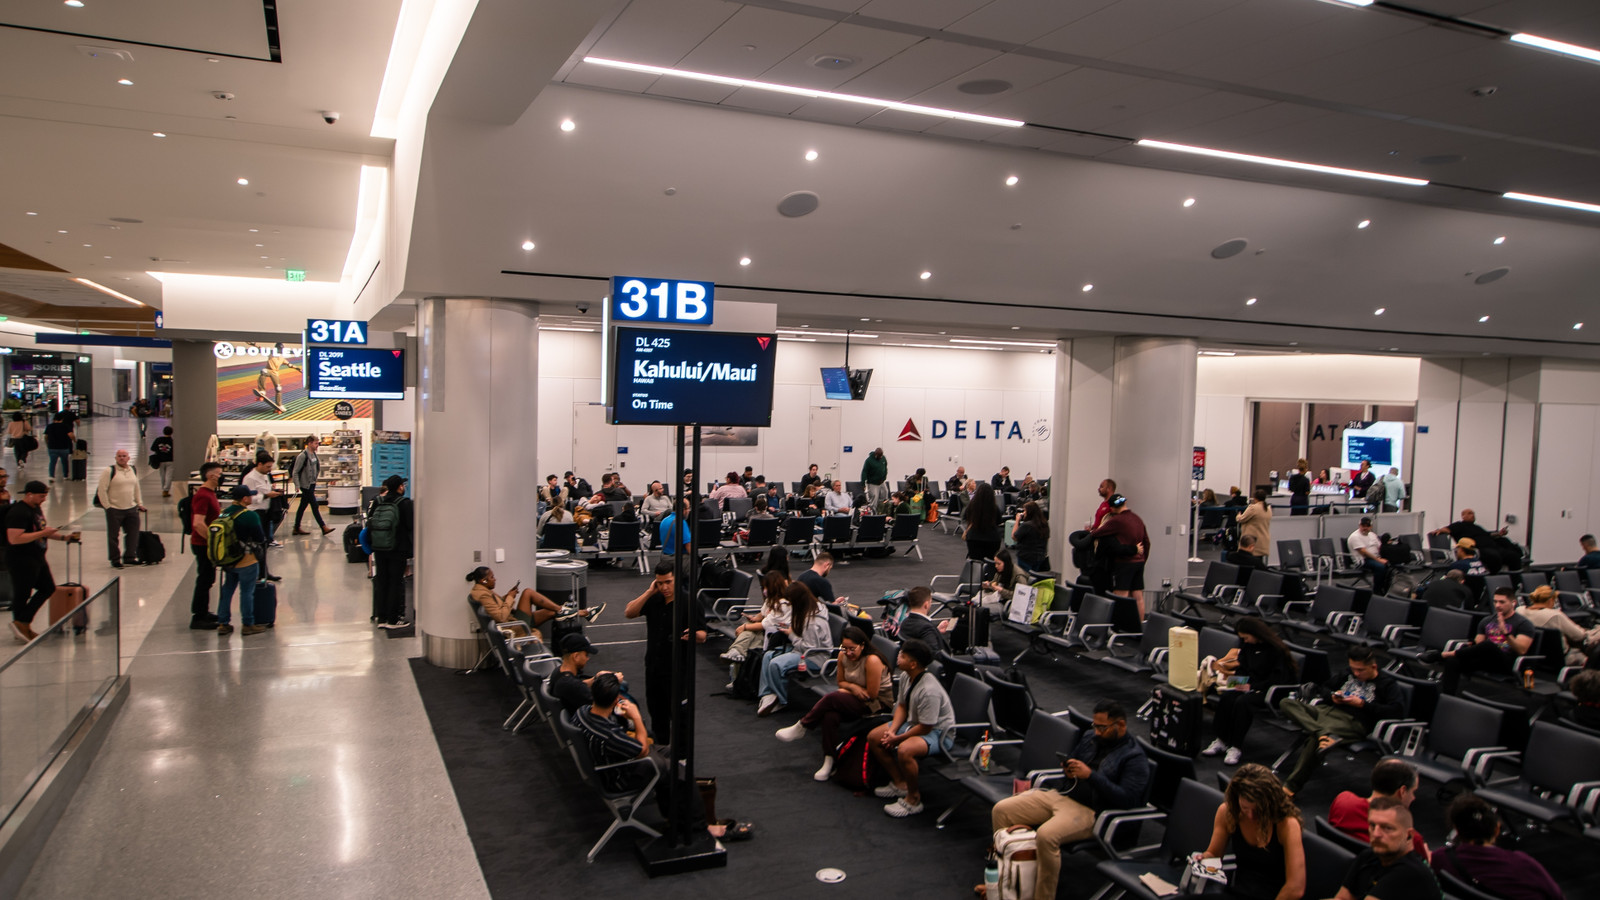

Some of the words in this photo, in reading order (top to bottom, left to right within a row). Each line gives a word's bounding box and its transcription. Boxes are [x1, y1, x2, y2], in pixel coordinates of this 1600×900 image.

[620, 280, 707, 320] 31B
[311, 320, 365, 343] 31A
[636, 337, 650, 347] DL
[651, 338, 671, 348] 425
[319, 361, 382, 378] Seattle
[633, 359, 758, 382] Kahului/Maui
[632, 399, 648, 409] On
[649, 399, 674, 410] Time
[931, 419, 1023, 440] DELTA
